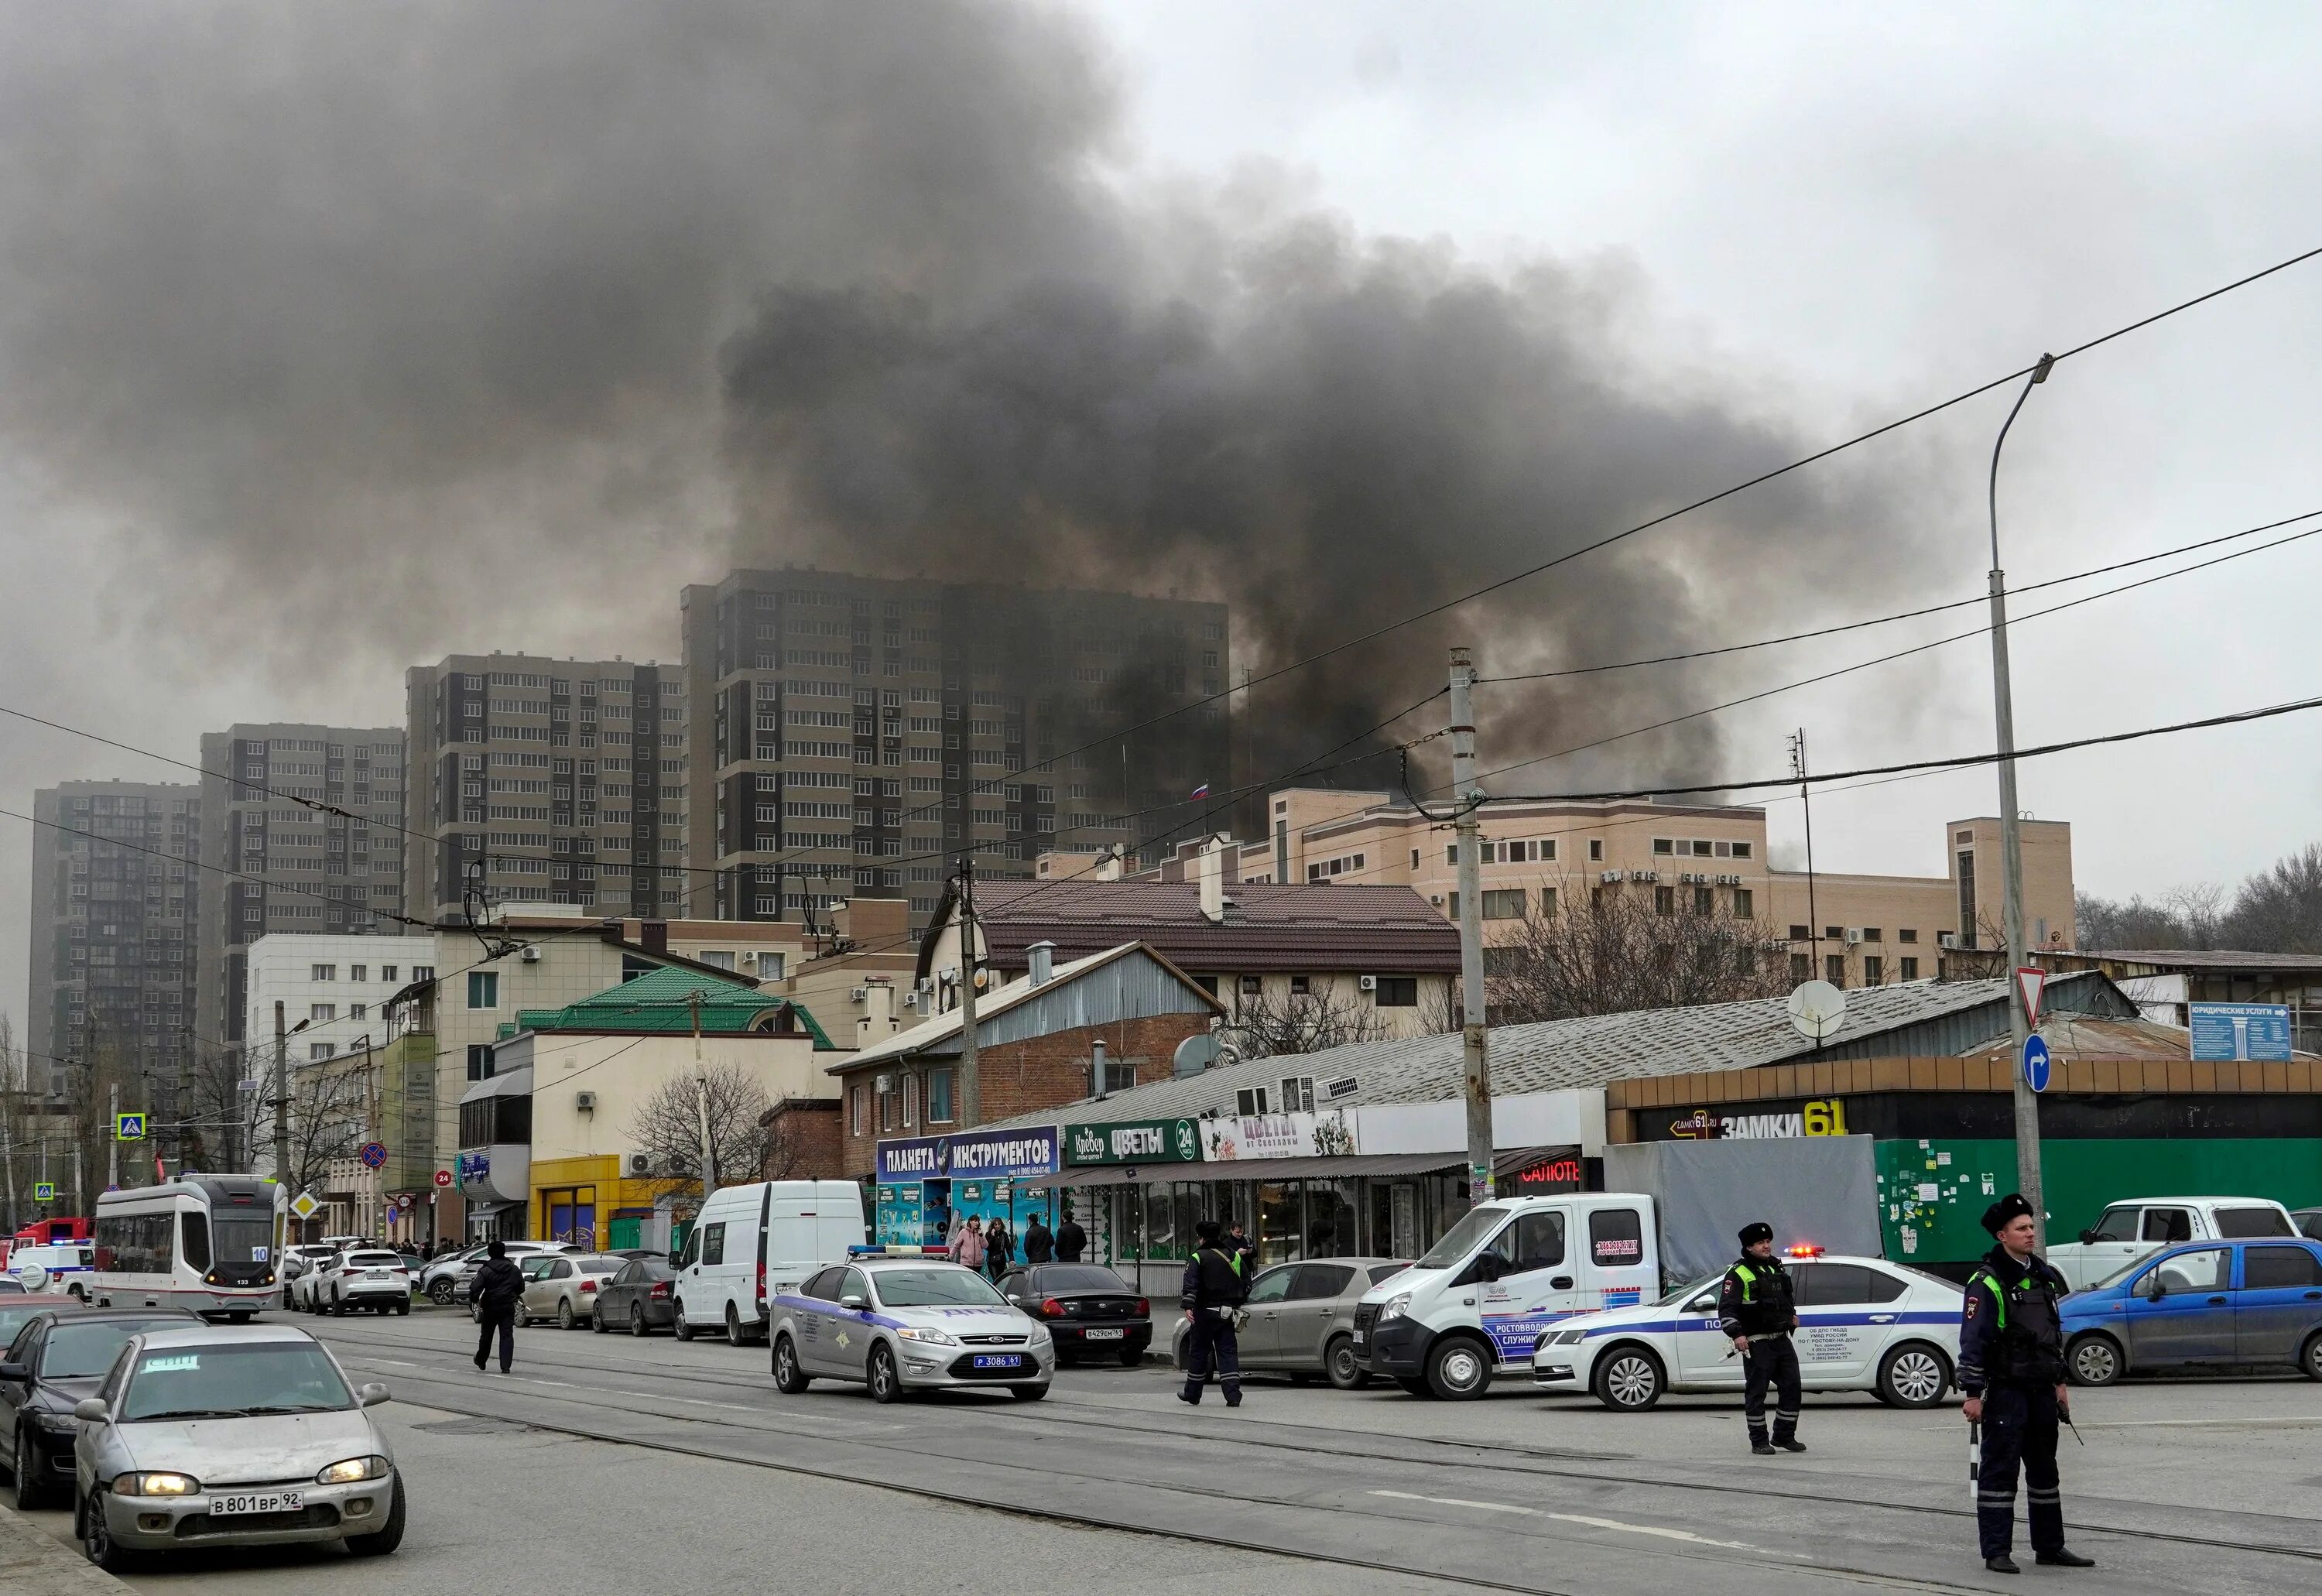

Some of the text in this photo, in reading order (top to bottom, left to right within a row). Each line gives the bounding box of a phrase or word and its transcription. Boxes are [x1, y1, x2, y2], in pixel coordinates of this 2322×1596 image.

[1179, 1128, 1193, 1148] 24
[1243, 1117, 1297, 1139] ЦВЕТЫ
[1075, 1130, 1104, 1159] Клевер
[1111, 1128, 1164, 1159] ЦВЕТЫ
[1259, 1138, 1299, 1147] Светланы
[886, 1139, 1050, 1172] ПЛАНЕТА ИНСТРУМЕНТОВ
[254, 1249, 266, 1260] 10
[943, 1308, 1009, 1317] ДПС
[283, 1494, 298, 1505] 92
